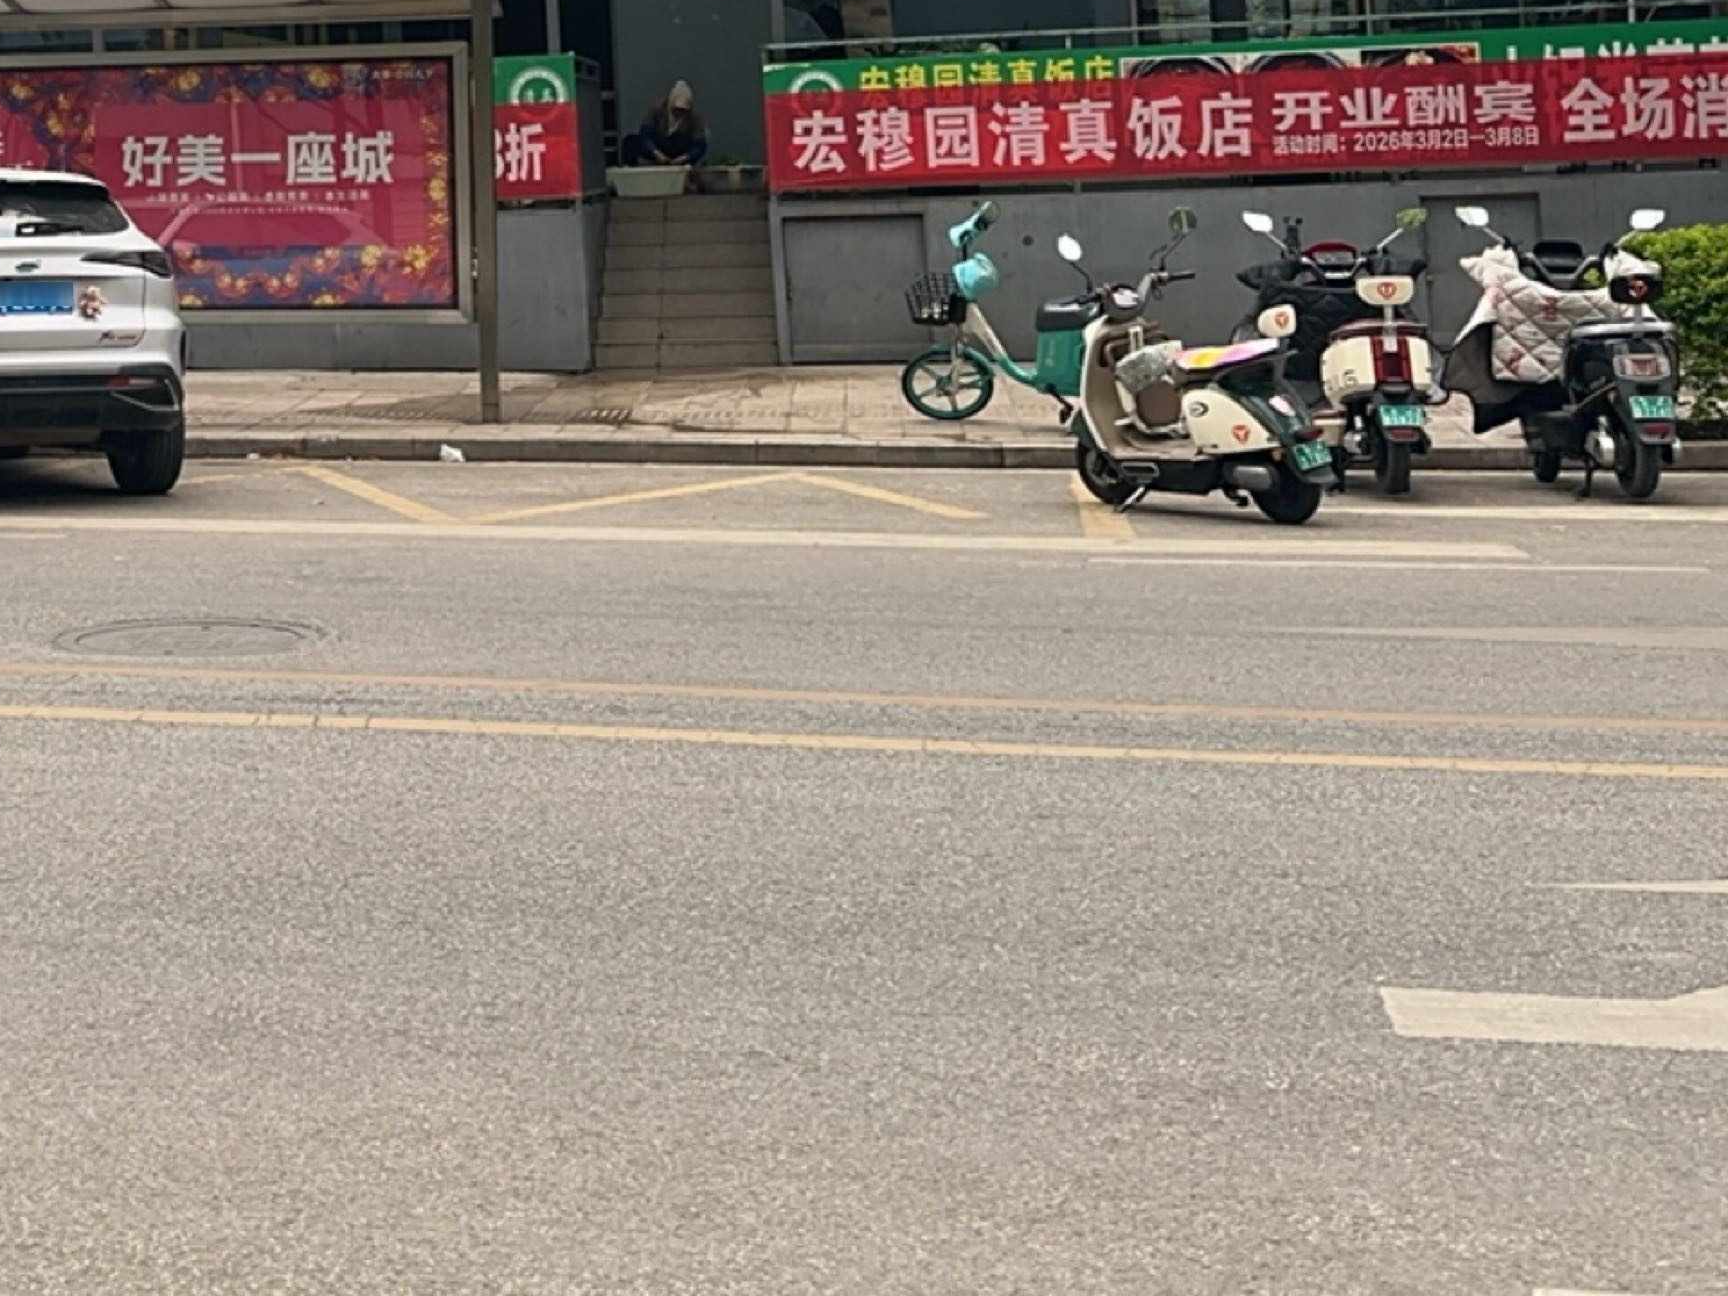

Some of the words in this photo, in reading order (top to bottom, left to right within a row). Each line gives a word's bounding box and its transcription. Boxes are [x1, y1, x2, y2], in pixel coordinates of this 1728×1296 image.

[122, 130, 394, 188] 好美一座城
[792, 92, 1253, 173] 宏穆园清真饭店
[1272, 80, 1537, 132] 开业酬宾
